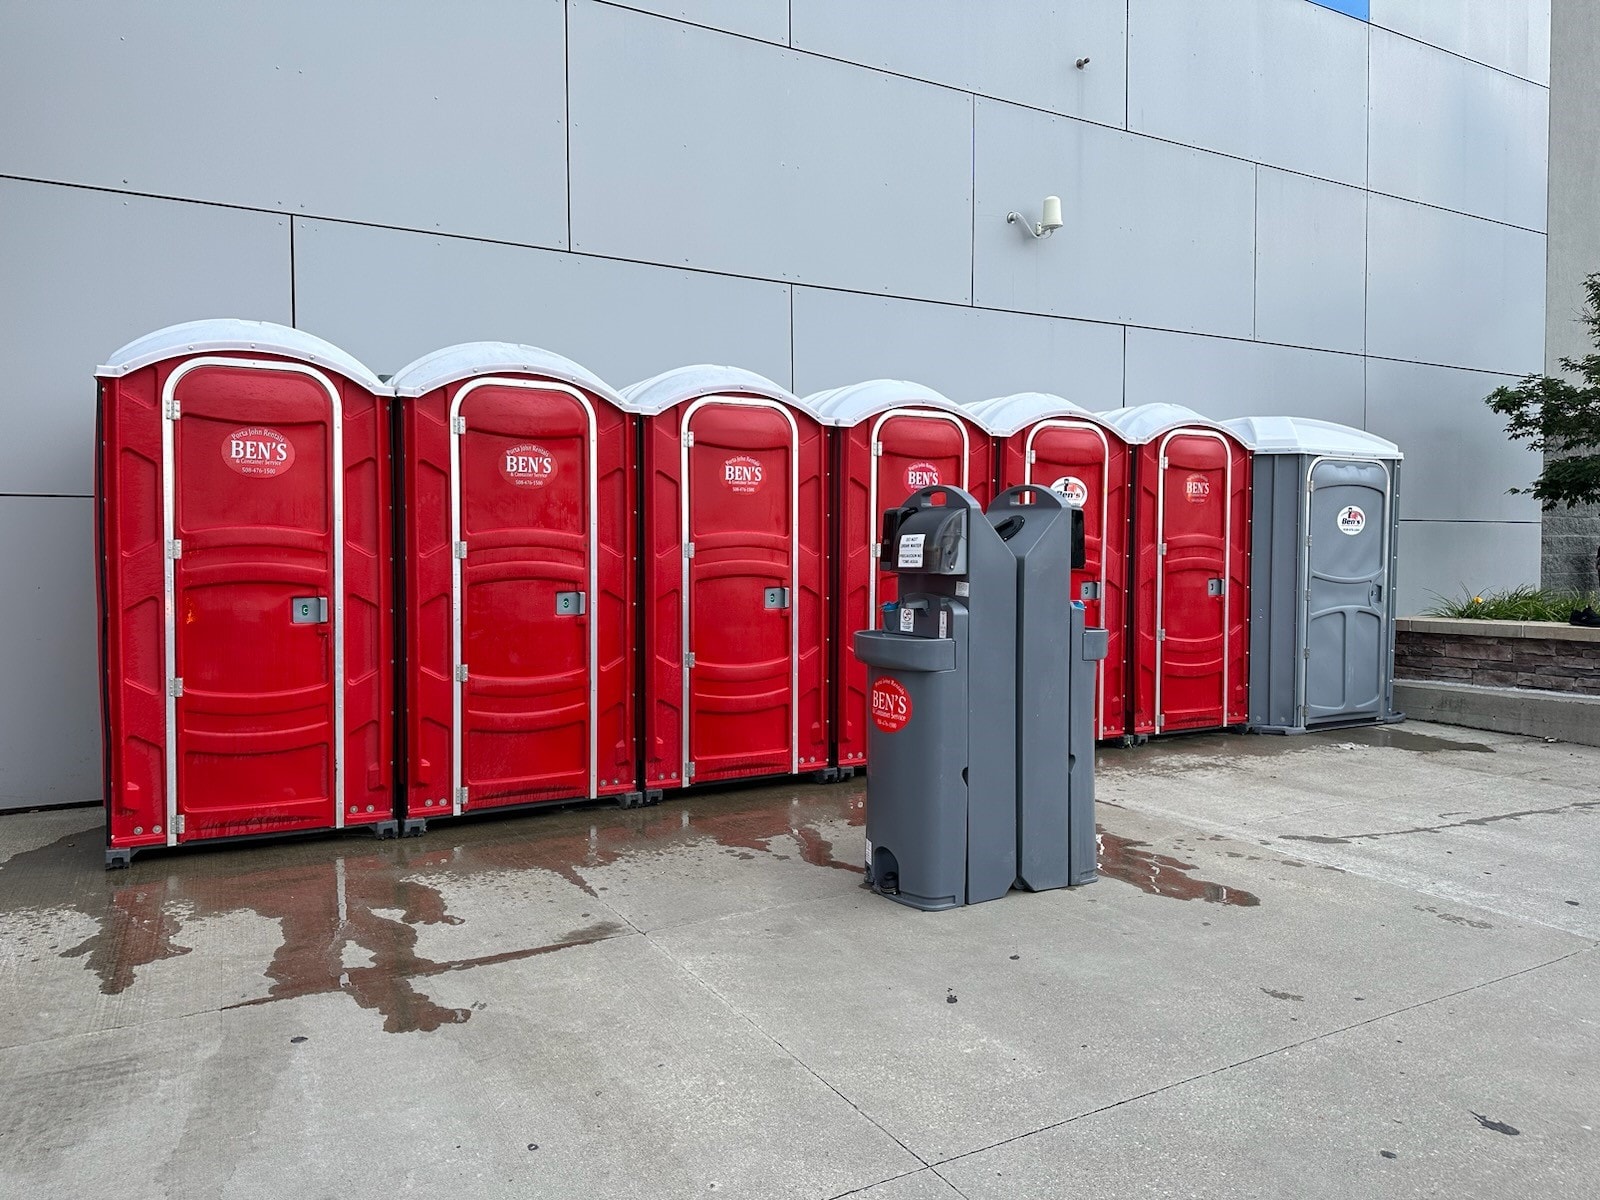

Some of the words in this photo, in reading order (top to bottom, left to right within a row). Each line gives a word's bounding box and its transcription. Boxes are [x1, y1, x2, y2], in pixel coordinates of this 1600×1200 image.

[231, 430, 248, 440] Porta
[248, 428, 262, 436] John
[263, 429, 284, 442] Rentals
[231, 440, 287, 461] BEN'S
[506, 455, 552, 474] BEN'S
[725, 465, 762, 482] BEN'S
[908, 471, 939, 486] BEN'S
[1186, 481, 1210, 495] BEN'S
[872, 689, 907, 714] BEN'S
